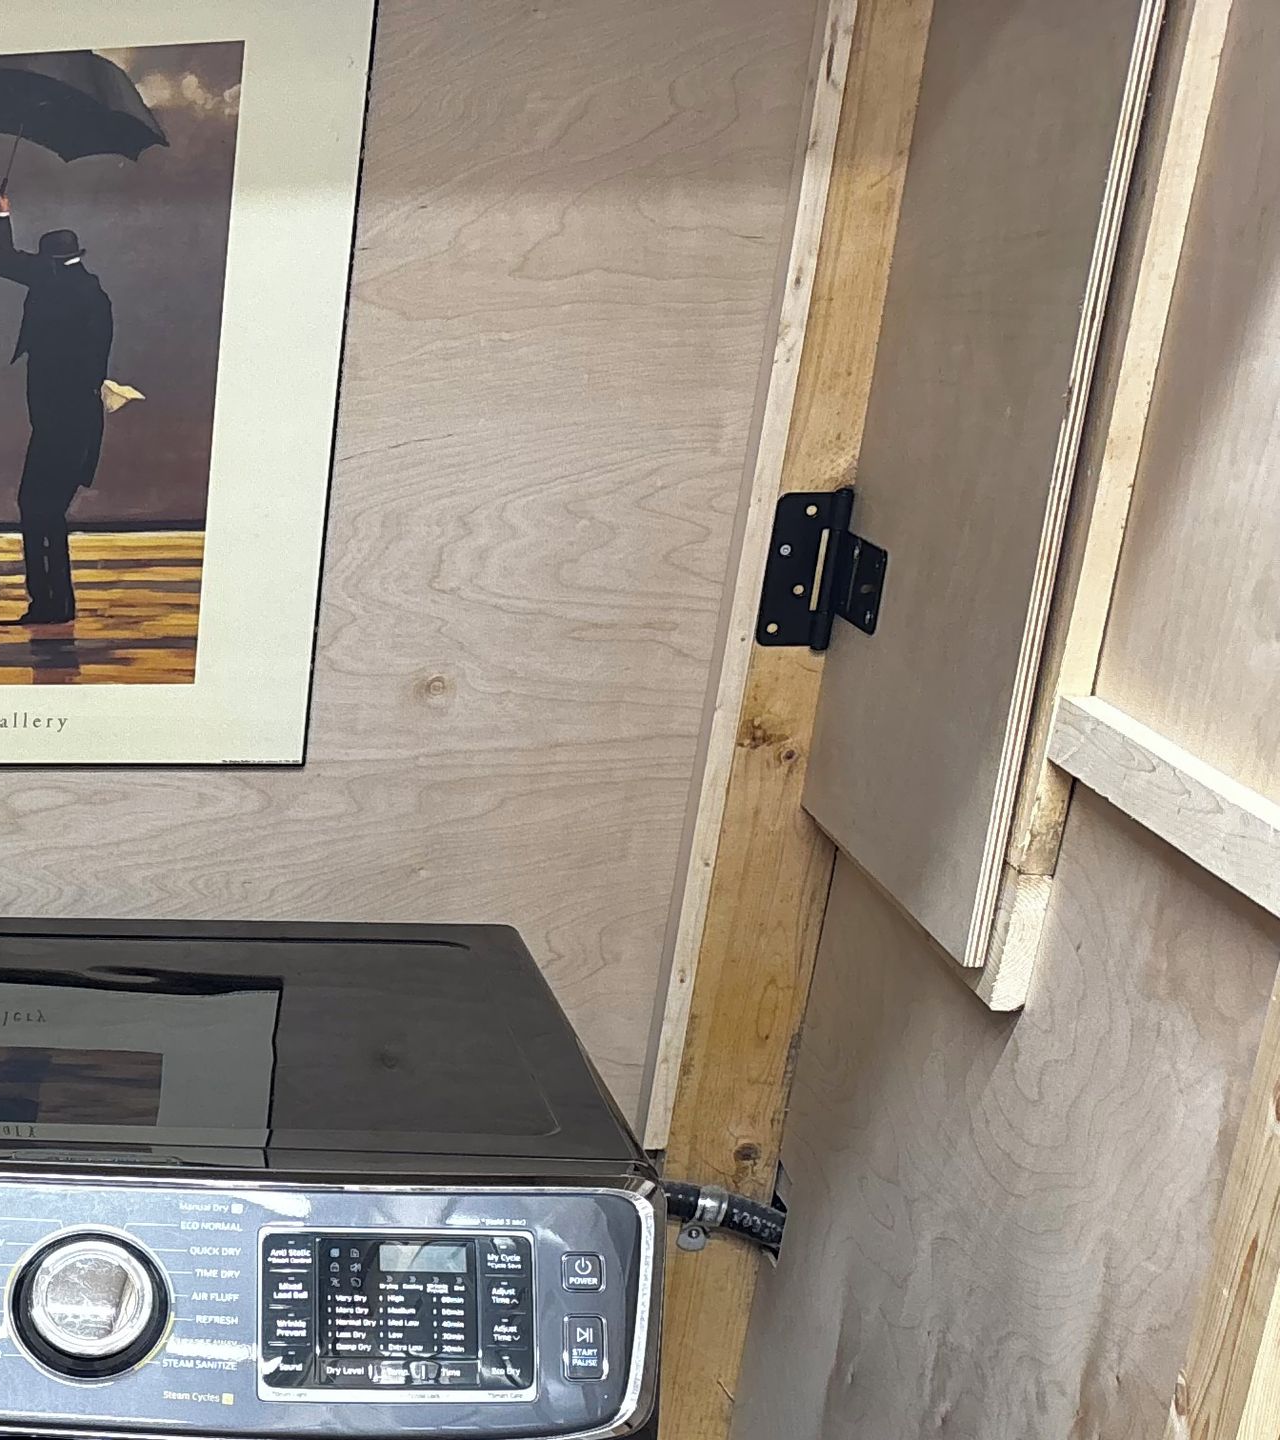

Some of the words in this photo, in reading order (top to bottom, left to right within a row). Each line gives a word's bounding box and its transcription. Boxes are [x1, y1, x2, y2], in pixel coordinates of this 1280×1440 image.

[179, 1202, 211, 1211] Manual
[213, 1203, 230, 1213] Dry
[180, 1221, 199, 1230] ECO
[200, 1222, 243, 1232] NORMAL
[189, 1246, 219, 1256] QUICK
[221, 1248, 242, 1256] DRY
[487, 1253, 499, 1262] My
[500, 1253, 521, 1263] Cycle
[195, 1269, 218, 1278] TIME
[220, 1270, 240, 1279] DRY
[569, 1276, 598, 1285] POWER
[191, 1291, 209, 1301] AIR
[210, 1293, 240, 1302] FLUFF
[491, 1287, 516, 1296] Adjust
[492, 1296, 510, 1305] Time
[196, 1315, 239, 1325] REFRESH
[493, 1325, 518, 1333] Adjust
[493, 1334, 512, 1342] Time
[572, 1349, 598, 1357] START
[162, 1358, 194, 1368] STEAM
[195, 1360, 238, 1370] SANITIZE
[572, 1358, 598, 1367] PAUSE
[326, 1366, 341, 1376] Dry
[342, 1366, 365, 1375] Level
[163, 1390, 190, 1400] Steam
[192, 1392, 220, 1403] Cycles
